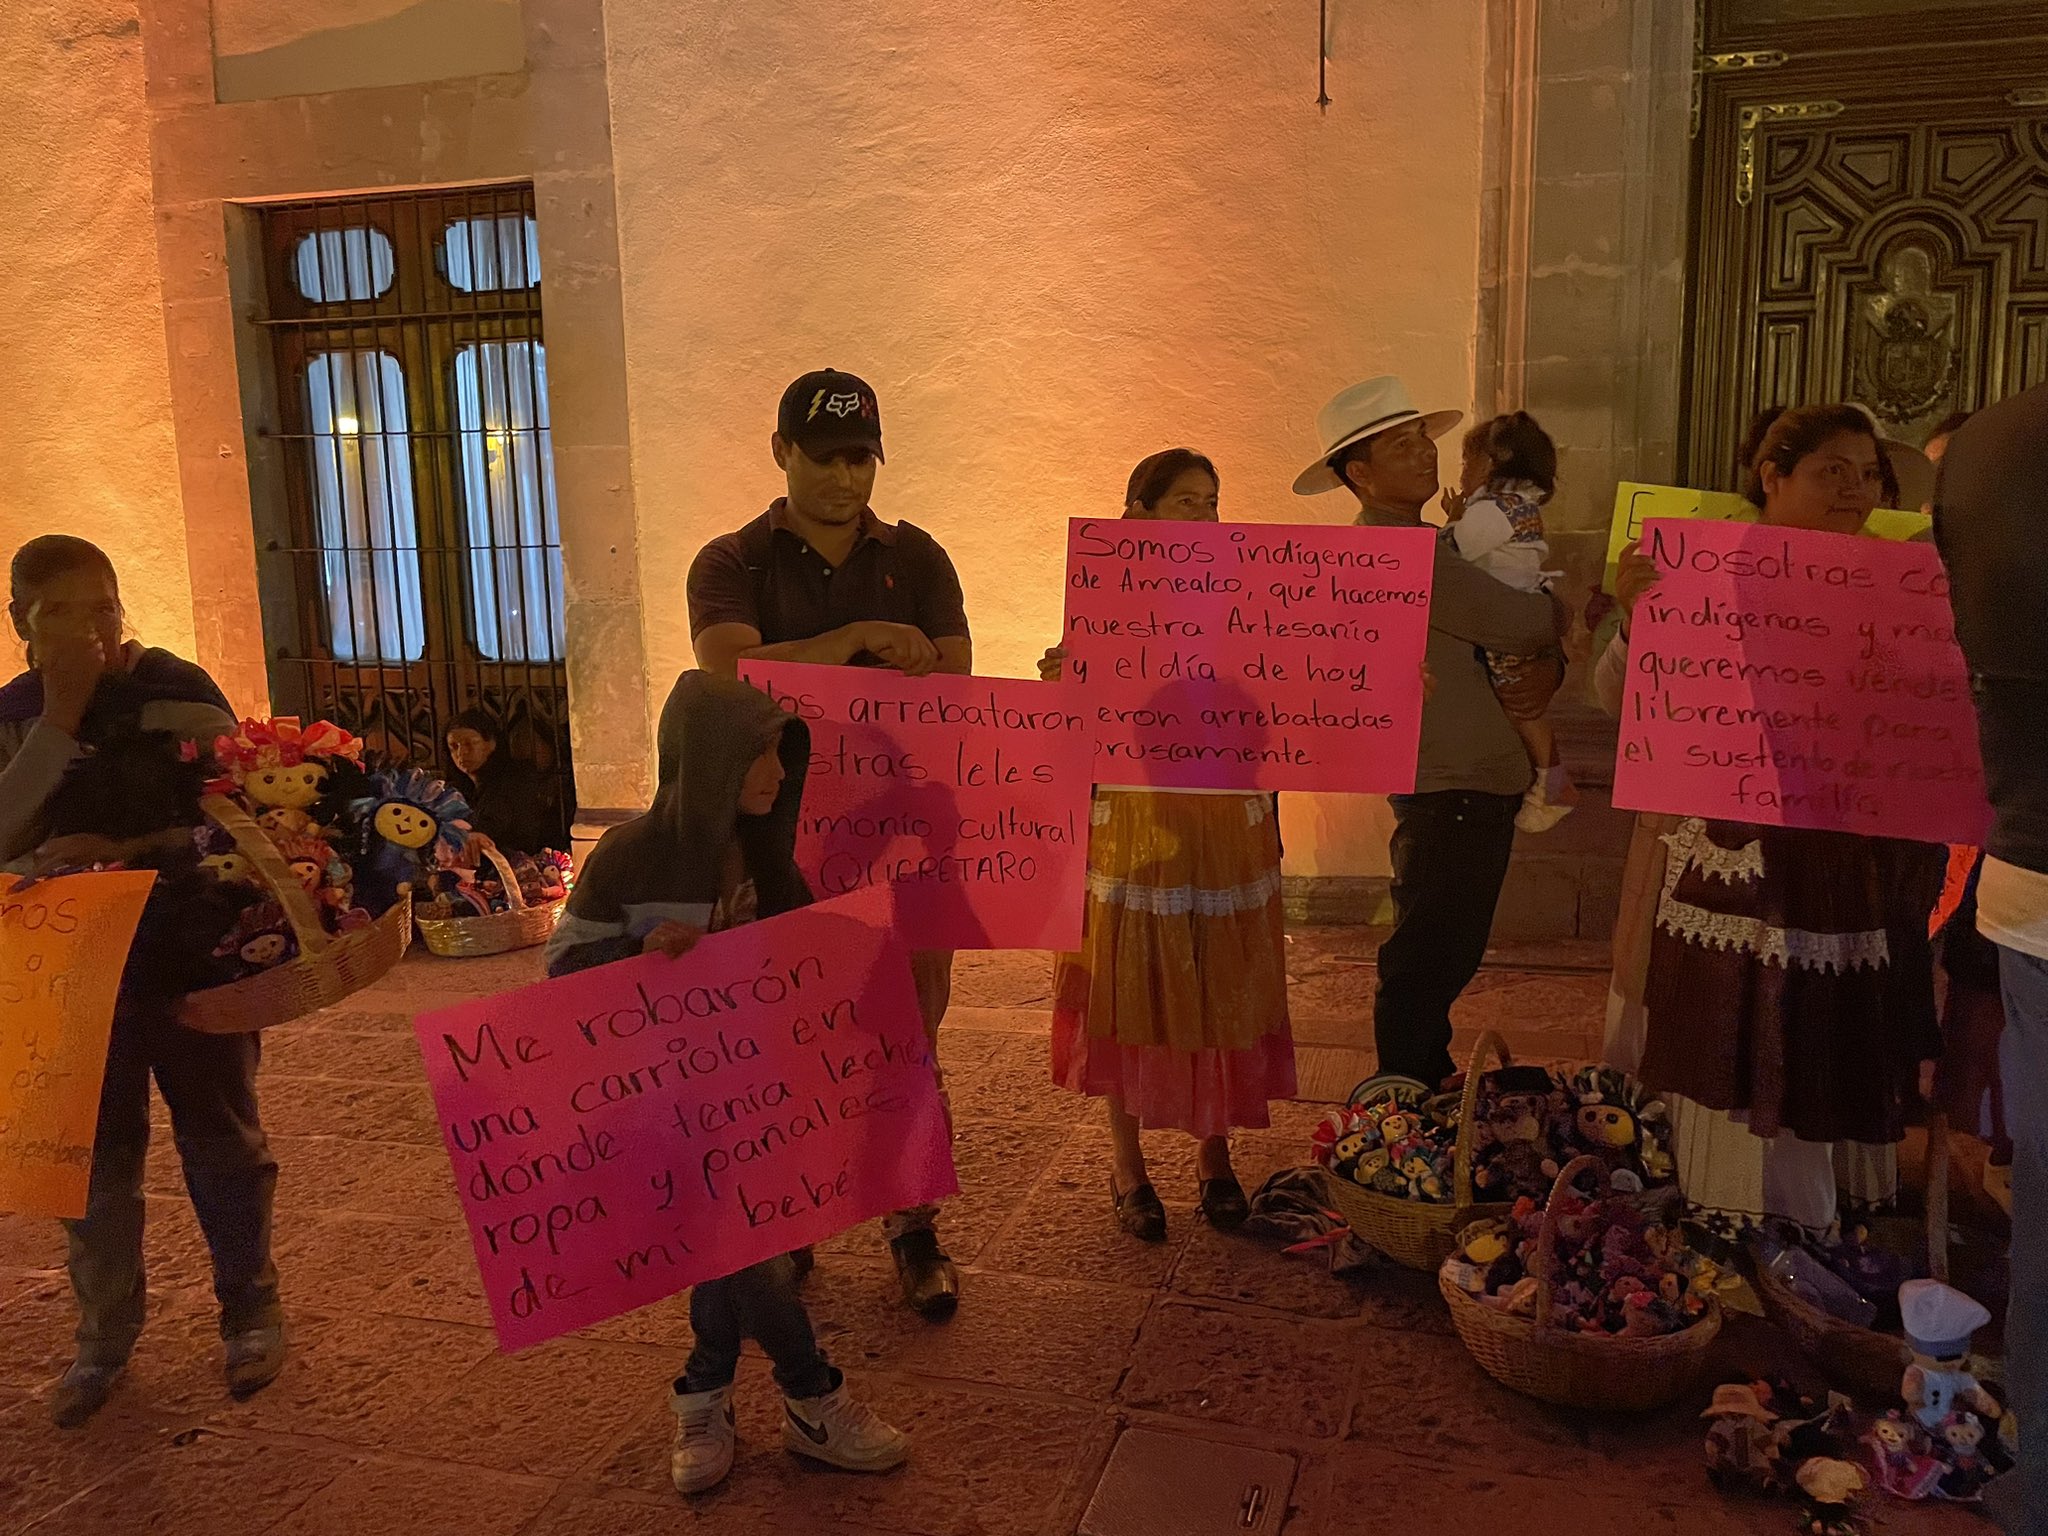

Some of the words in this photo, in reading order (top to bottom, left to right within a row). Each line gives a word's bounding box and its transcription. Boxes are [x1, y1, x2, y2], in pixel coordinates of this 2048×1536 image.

[1075, 523, 1215, 564] Somos
[1650, 527, 1876, 589] Nosotras
[1071, 565, 1101, 590] de
[1118, 568, 1253, 601] Amealco,
[1269, 581, 1317, 609] que
[1332, 575, 1429, 607] hacemos
[1069, 611, 1205, 638] nuestra
[1858, 621, 1876, 660] y
[1073, 659, 1088, 684] y
[1115, 645, 1146, 680] el
[1159, 651, 1216, 682] día
[1243, 652, 1290, 682] de
[1306, 651, 1372, 692] hoy
[1639, 651, 1826, 693] queremos
[743, 674, 825, 719] os
[850, 692, 1084, 731] arrebataron
[1098, 707, 1181, 728] eron
[1200, 698, 1394, 730] arrebatadas
[1635, 690, 1840, 731] libremente
[1863, 712, 1952, 741] para
[808, 735, 928, 780] stras
[957, 741, 1055, 786] leles
[1624, 737, 1654, 764] el
[1684, 733, 1835, 770] sustento
[799, 806, 932, 838] imonio
[958, 807, 1076, 845] cultural
[443, 1023, 552, 1081] Me
[577, 955, 824, 1046] robarón
[451, 1103, 538, 1154] una
[571, 1031, 761, 1114] carriola
[792, 999, 859, 1047] en
[483, 1194, 608, 1254] ropa
[651, 1169, 674, 1211] y
[702, 1085, 912, 1200] pañales
[510, 1266, 591, 1320] de
[738, 1159, 851, 1228] bebé
